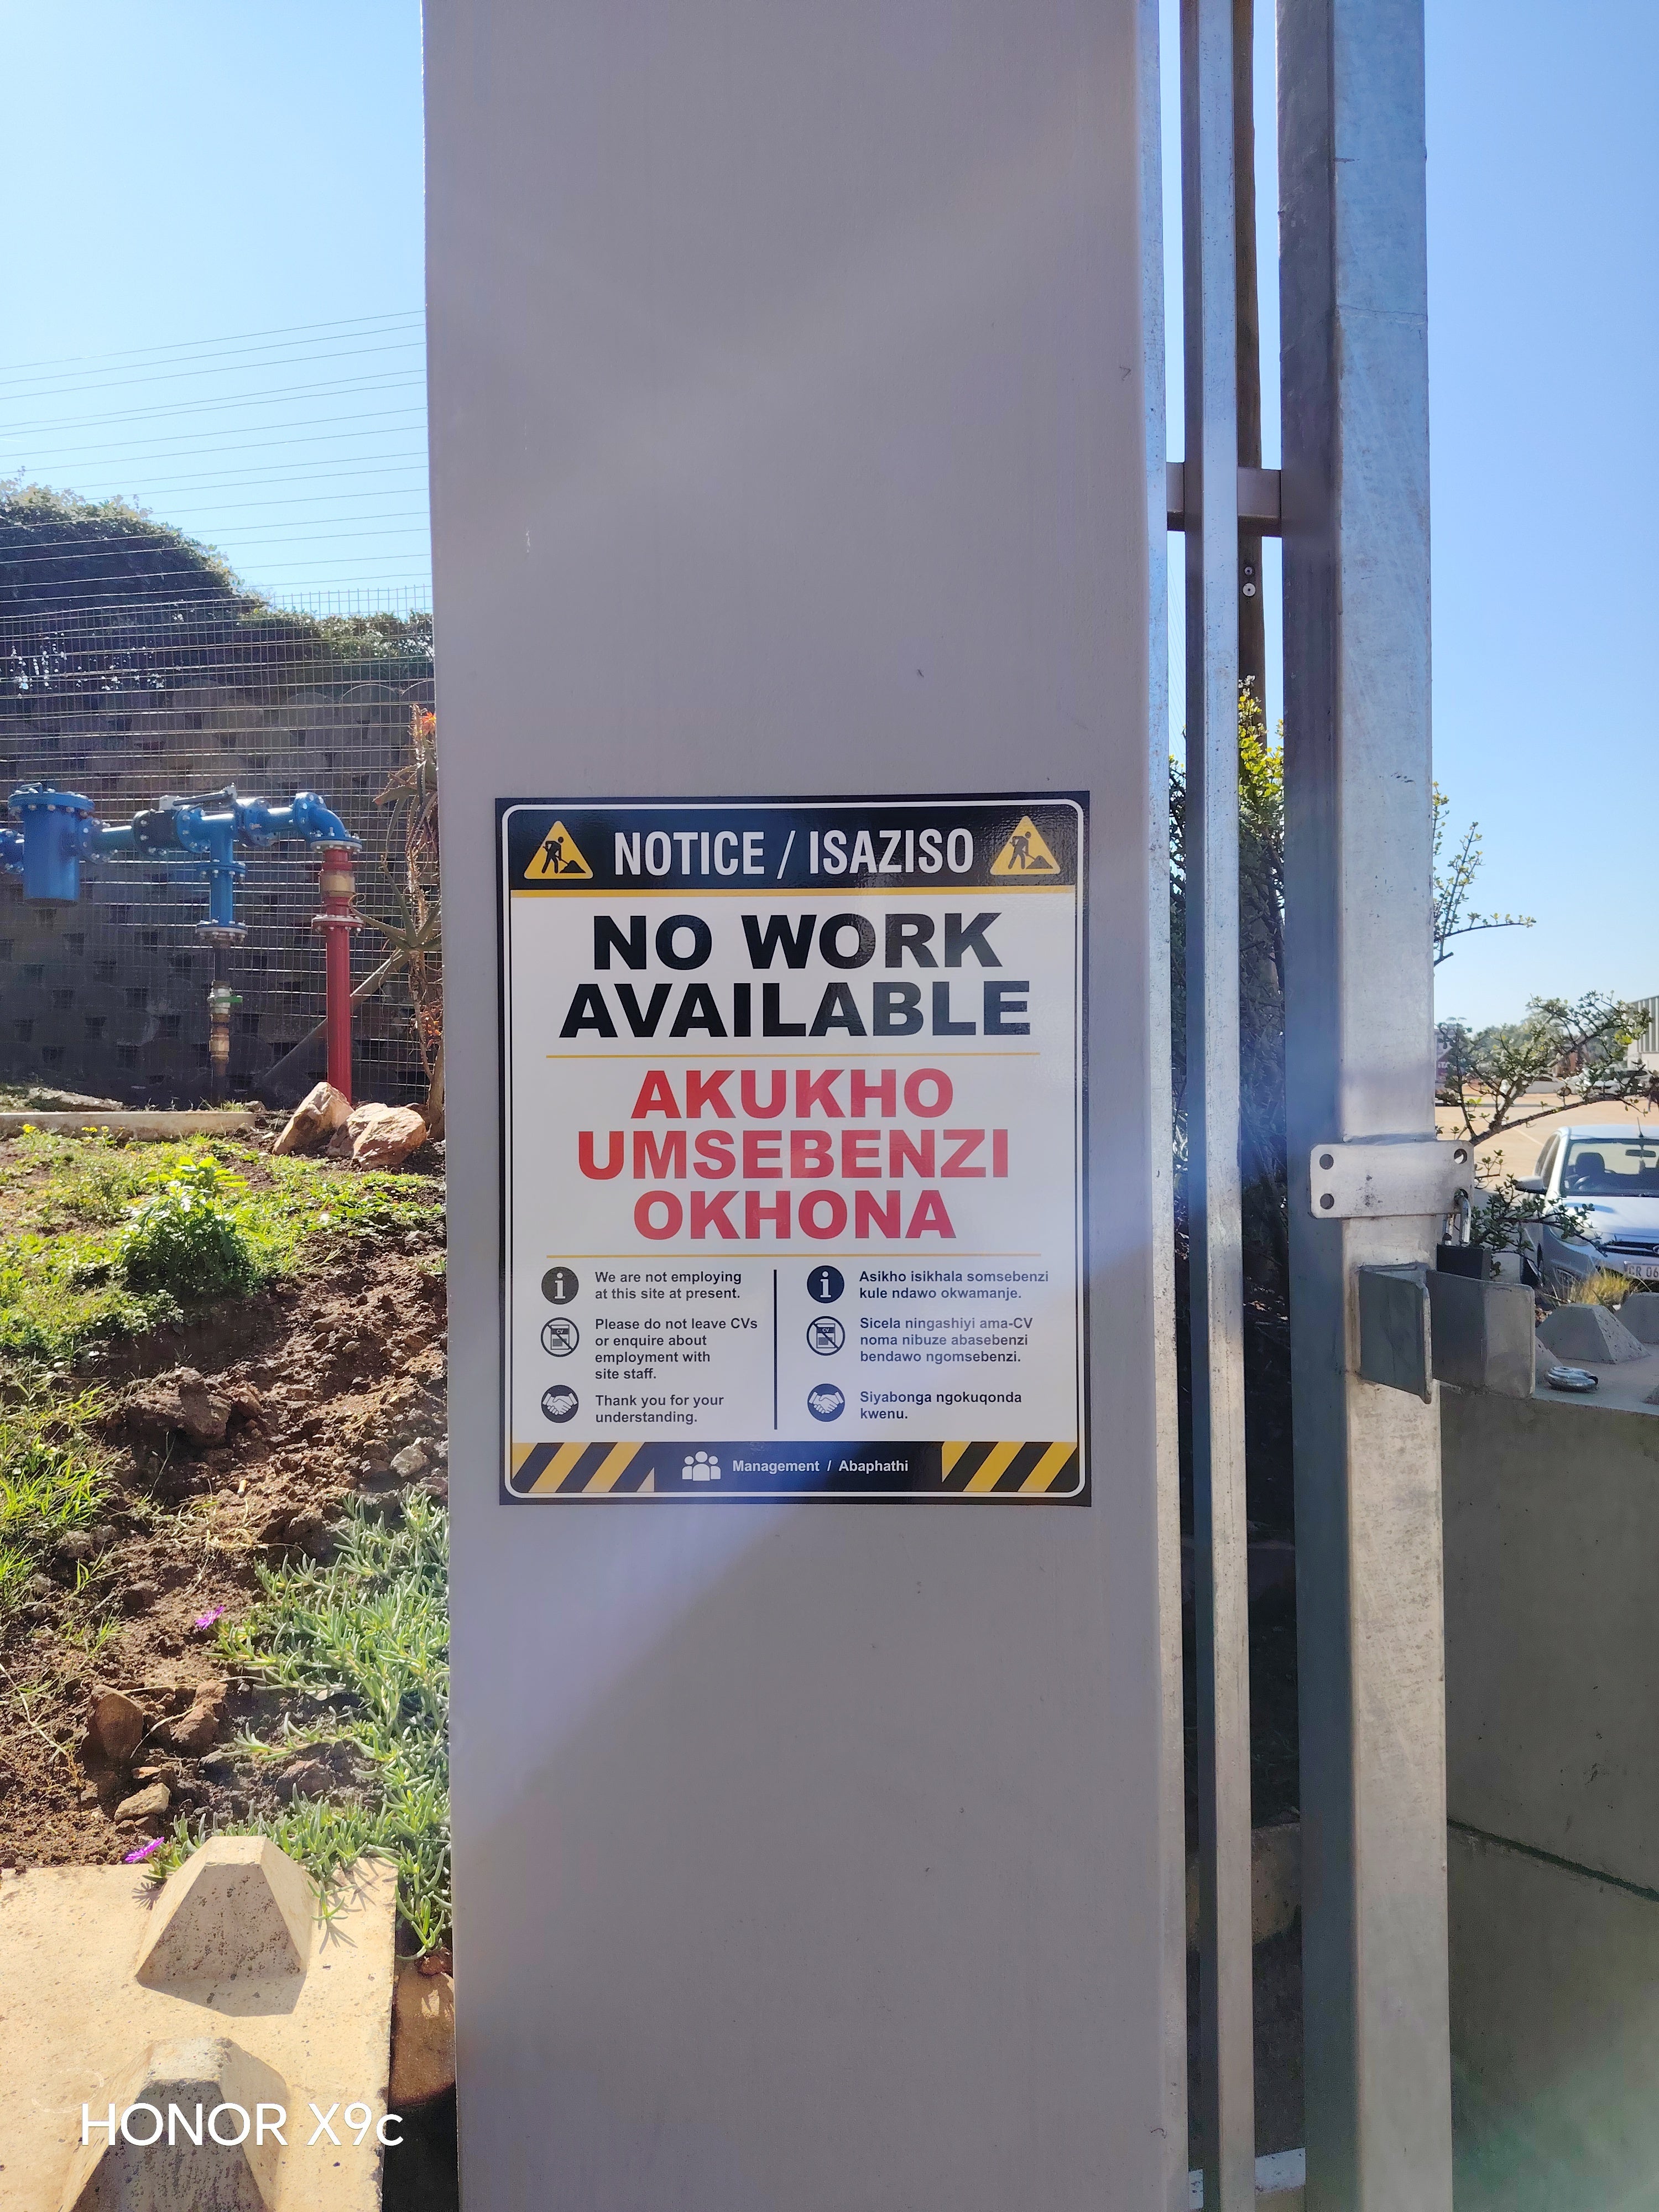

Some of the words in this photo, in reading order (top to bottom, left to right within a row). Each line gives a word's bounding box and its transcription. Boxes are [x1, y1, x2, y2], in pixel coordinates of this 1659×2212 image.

[615, 831, 764, 875] NOTICE
[777, 831, 795, 879] /
[810, 828, 973, 874] ISAZISO
[594, 915, 712, 970] NO
[741, 913, 1002, 969] WORK
[559, 981, 1030, 1037] AVAILABLE
[631, 1068, 953, 1119] AKUKHO
[579, 1129, 1008, 1180] UMSEBENZI
[634, 1190, 956, 1240] OKHONA
[595, 1272, 615, 1282] We
[646, 1272, 667, 1282] not
[671, 1271, 741, 1285] employing
[859, 1271, 906, 1281] Asikho
[911, 1271, 962, 1281] isikhala
[967, 1271, 1048, 1281] somsebenzi
[596, 1289, 607, 1299] at
[612, 1288, 636, 1298] this
[641, 1288, 664, 1298] site
[670, 1288, 681, 1298] at
[686, 1288, 739, 1301] present.
[860, 1287, 887, 1298] kule
[893, 1287, 936, 1298] ndawo
[941, 1287, 1021, 1301] okwamanje.
[596, 1319, 639, 1329] Please
[645, 1318, 660, 1329] do
[666, 1319, 687, 1329] not
[692, 1318, 726, 1328] leave
[731, 1318, 757, 1328] CVs
[860, 1318, 900, 1328] Sicela
[906, 1318, 974, 1331] ningashiyi
[980, 1318, 1032, 1328] ama-CV
[614, 1335, 664, 1348] enquire
[669, 1335, 706, 1345] about
[902, 1334, 946, 1345] nibuze
[952, 1334, 1027, 1345] abasebenzi
[596, 1352, 678, 1365] employment
[682, 1352, 709, 1361] with
[861, 1351, 921, 1361] bendawo
[927, 1351, 1020, 1364] ngomsebenzi.
[596, 1369, 619, 1379] site
[624, 1368, 656, 1379] staff.
[596, 1395, 637, 1406] Thank
[641, 1397, 665, 1408] you
[670, 1395, 689, 1405] for
[693, 1397, 724, 1408] your
[860, 1391, 931, 1405] Siyabonga
[937, 1392, 1021, 1405] ngokuqonda
[596, 1411, 697, 1425] understanding.
[861, 1408, 907, 1418] kwenu.
[733, 1460, 820, 1475] Management
[827, 1460, 831, 1472] /
[838, 1460, 909, 1474] Abaphathi
